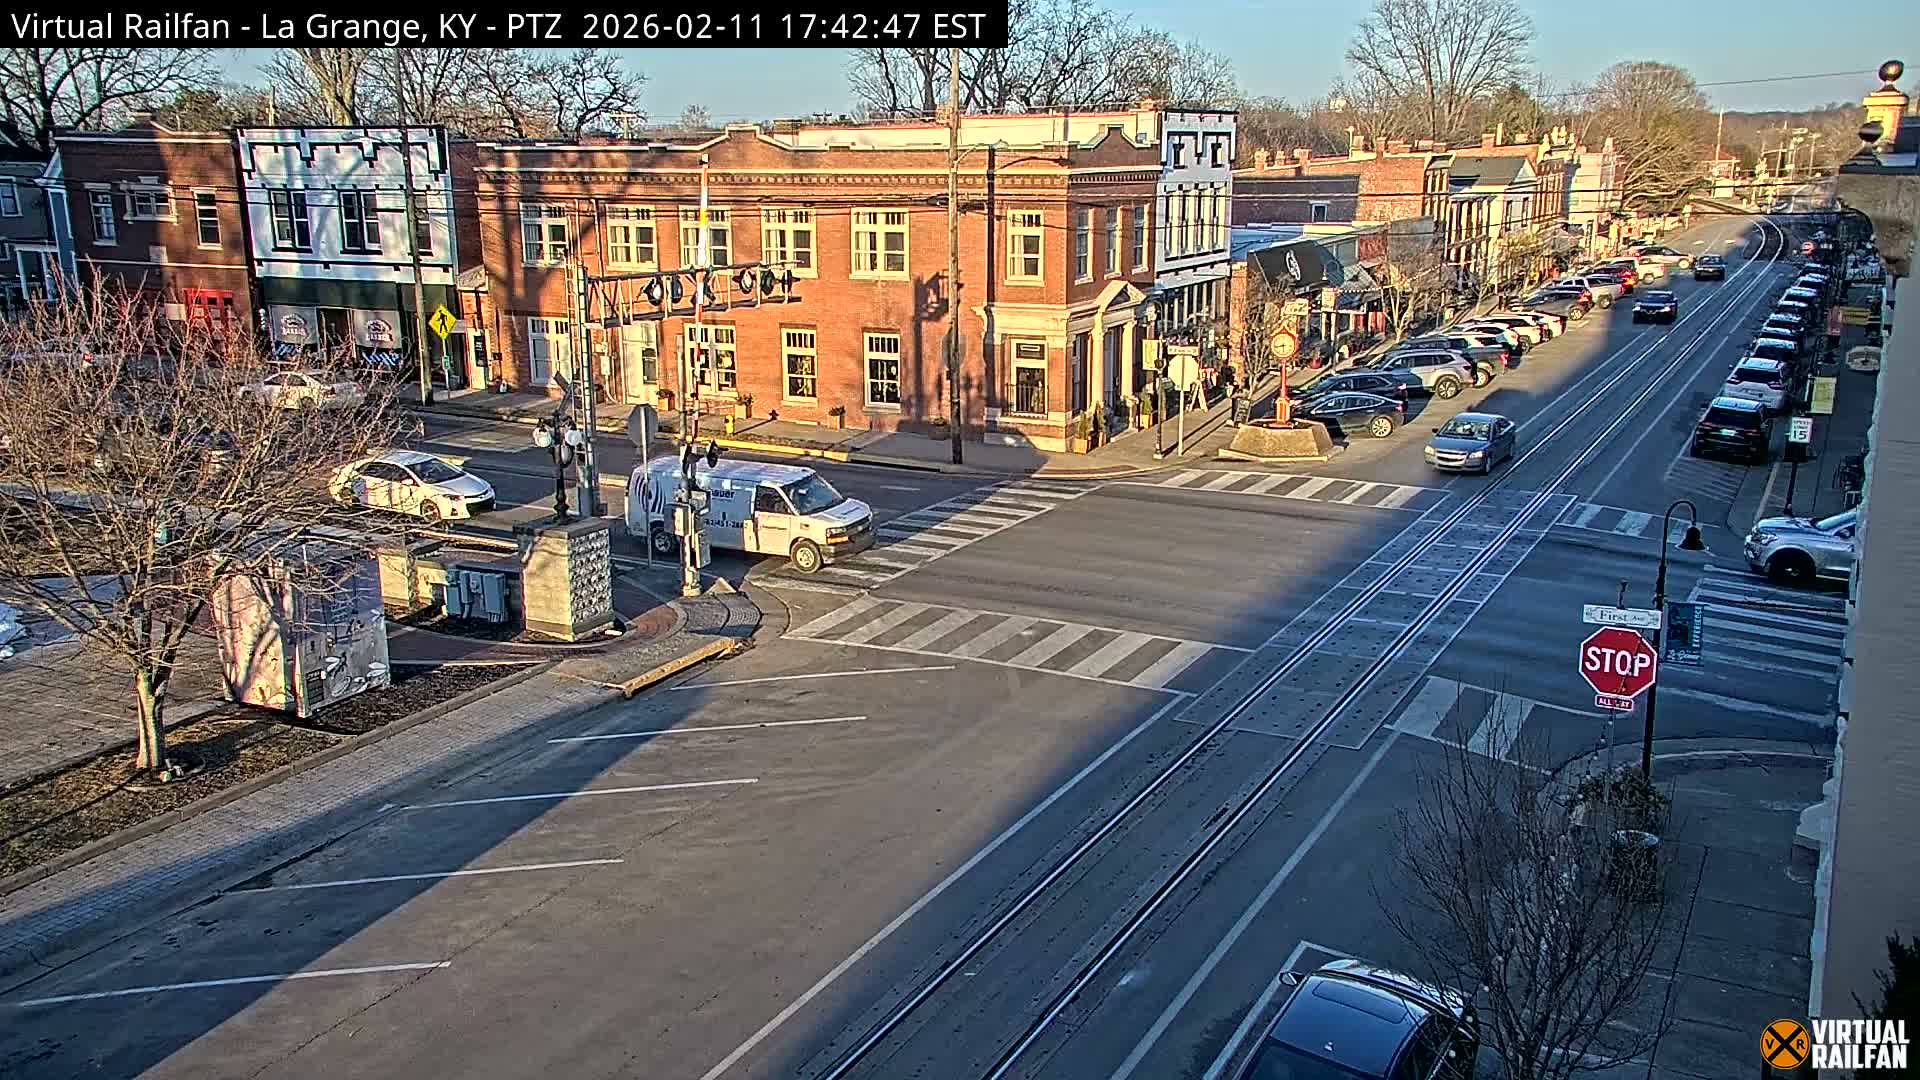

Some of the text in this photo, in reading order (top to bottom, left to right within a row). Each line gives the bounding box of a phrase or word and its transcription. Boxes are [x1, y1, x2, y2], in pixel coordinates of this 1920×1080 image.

[1793, 430, 1807, 440] 15
[1599, 609, 1628, 622] First
[1584, 645, 1651, 677] STOP
[1599, 697, 1612, 706] ALL
